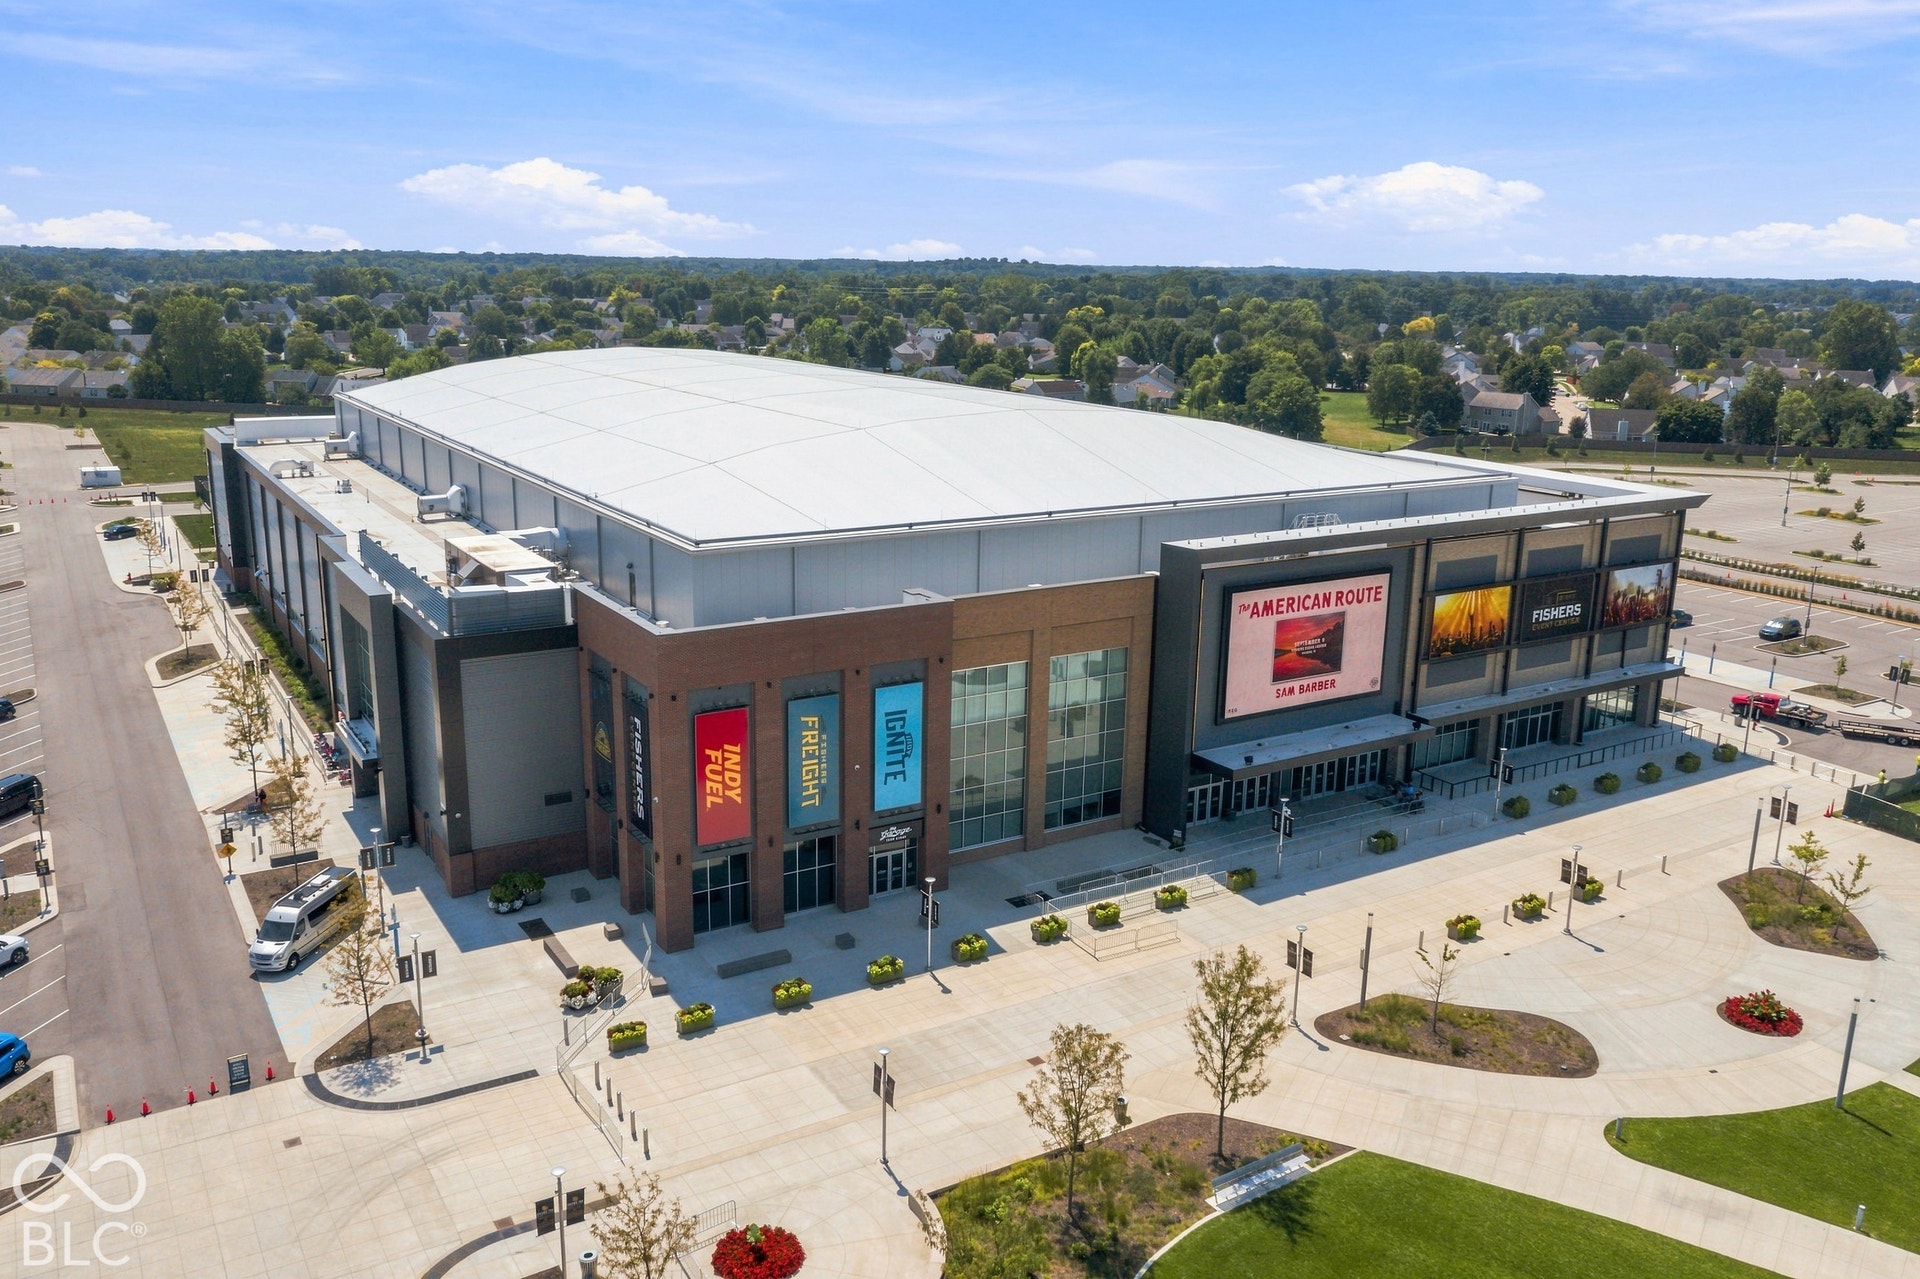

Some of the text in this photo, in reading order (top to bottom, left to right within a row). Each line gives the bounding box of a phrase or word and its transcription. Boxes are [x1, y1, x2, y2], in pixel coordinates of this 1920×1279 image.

[1238, 585, 1383, 619] The AMERICAN ROUTE
[1532, 603, 1581, 623] FISHERS
[1532, 617, 1580, 631] EVENT CENTER
[1275, 679, 1336, 699] SAM BARBER
[634, 717, 645, 820] FISHERS
[723, 743, 742, 804] INDY
[800, 716, 819, 807] FREIGHT
[884, 709, 907, 785] IGNITE
[705, 748, 723, 808] FUEL
